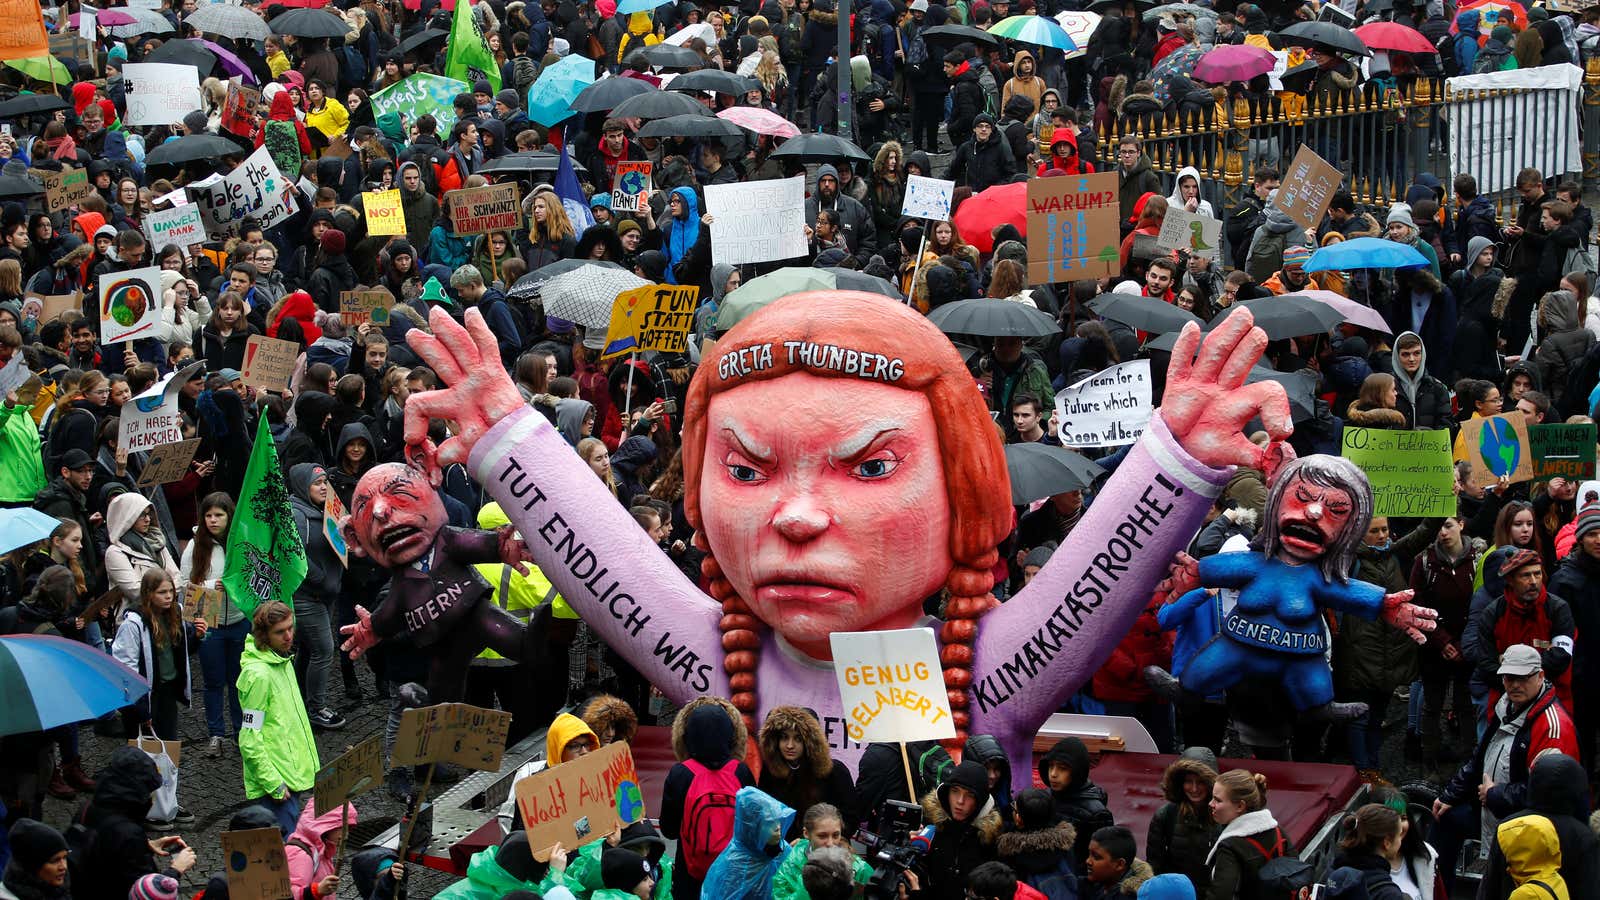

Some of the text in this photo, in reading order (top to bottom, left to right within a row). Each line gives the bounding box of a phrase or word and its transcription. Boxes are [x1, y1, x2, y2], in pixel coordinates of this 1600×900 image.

[637, 163, 651, 175] NO
[46, 178, 59, 190] GO
[191, 163, 270, 209] Make the
[51, 198, 65, 208] GO
[613, 191, 640, 209] PLANET
[1032, 191, 1113, 214] WARUM?
[153, 210, 199, 232] UMWELT
[369, 207, 397, 218] NOT
[455, 206, 469, 219] IHR
[169, 225, 195, 237] BANK
[1062, 221, 1073, 269] OHNE
[654, 289, 695, 312] TUN
[341, 311, 370, 326] TIME
[640, 310, 692, 329] STATT
[637, 328, 689, 350] HOFFEN
[717, 341, 906, 382] GRETA THUNBERG
[1116, 367, 1132, 384] for
[1137, 374, 1144, 382] a
[1064, 391, 1138, 415] future which
[127, 415, 172, 434] ICH HABE
[1062, 421, 1098, 442] Soon
[1102, 421, 1117, 441] will
[1118, 421, 1131, 440] be
[129, 428, 180, 449] MENSCHEN
[1380, 439, 1394, 449] ein
[500, 457, 713, 692] TUT ENDLICH WAS
[972, 473, 1184, 714] KLIMAKATASTROPHE!
[404, 580, 472, 632] ELTERN-
[1227, 615, 1323, 649] GENERATION
[845, 661, 929, 686] GENUG
[847, 687, 948, 740] GELABERT
[522, 778, 568, 830] Wacht
